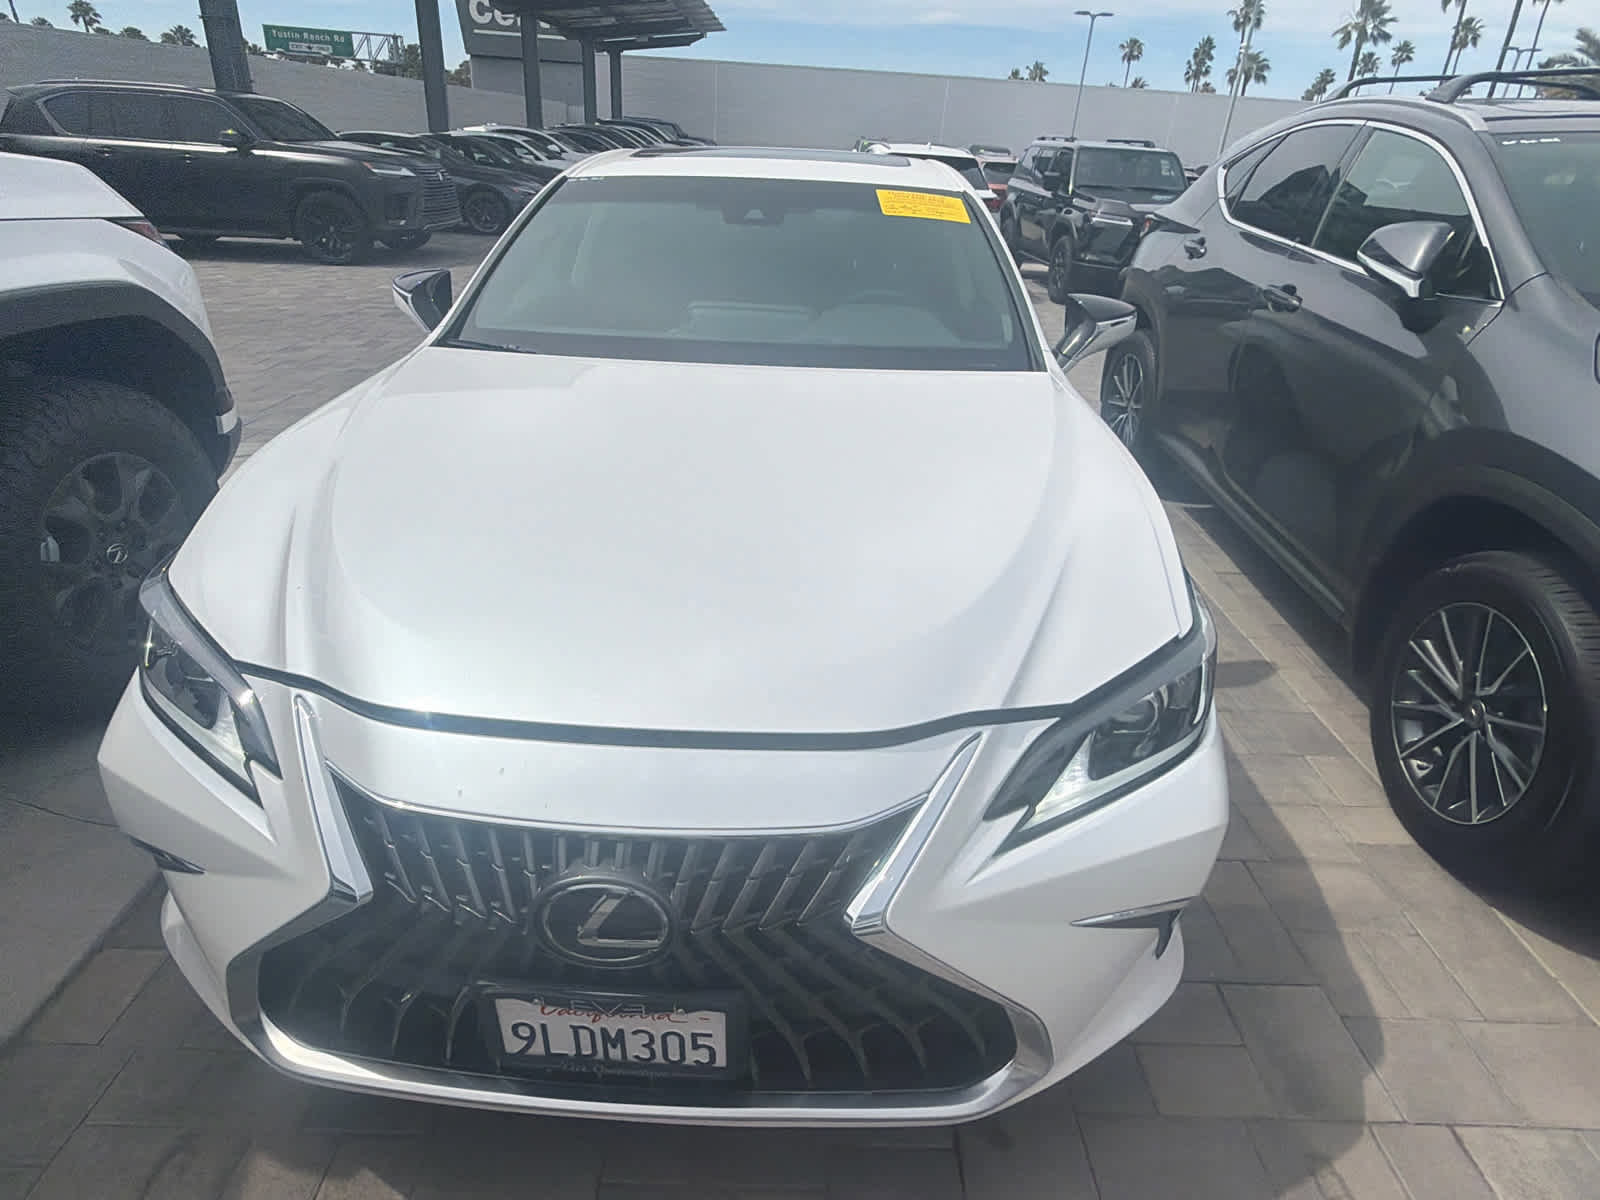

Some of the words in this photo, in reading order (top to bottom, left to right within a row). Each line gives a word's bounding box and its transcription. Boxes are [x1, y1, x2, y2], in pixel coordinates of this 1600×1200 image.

[271, 28, 301, 40] Tustin
[302, 31, 331, 42] Ranch
[510, 1021, 717, 1066] 9LDM305
